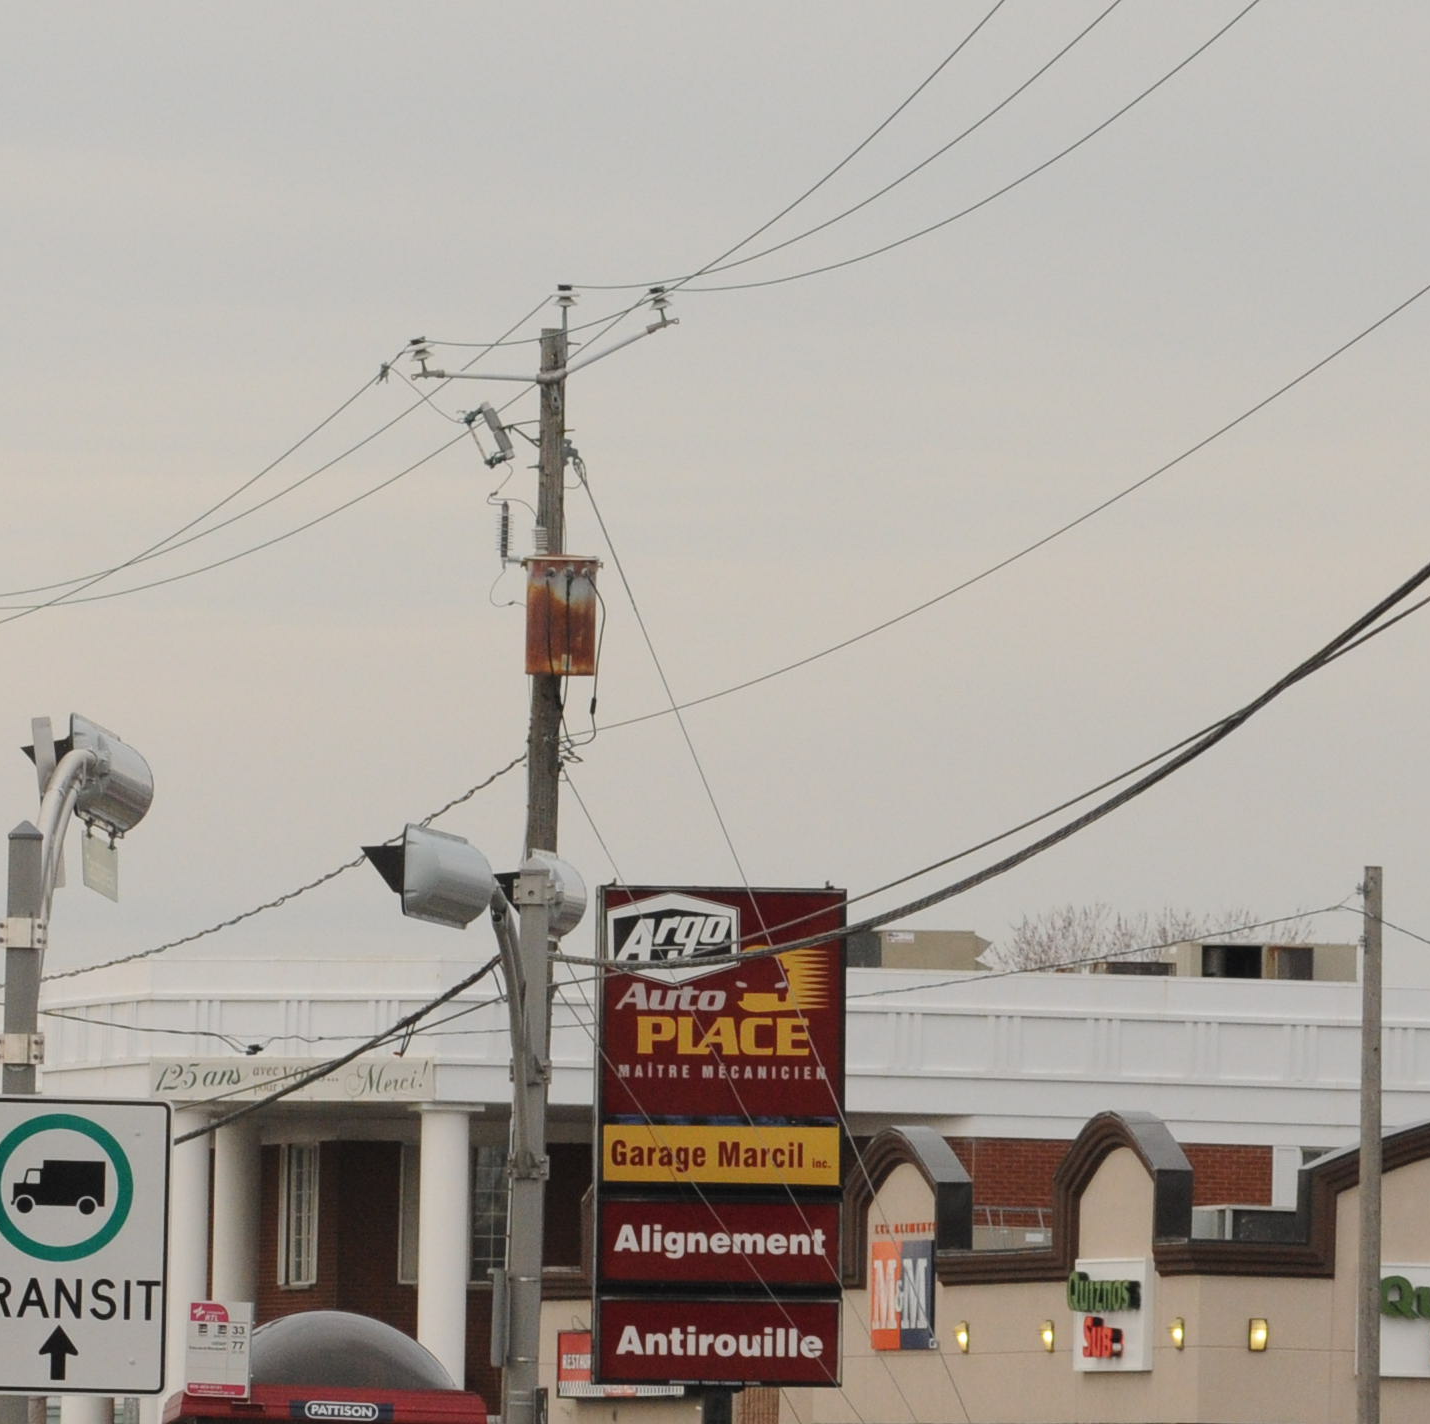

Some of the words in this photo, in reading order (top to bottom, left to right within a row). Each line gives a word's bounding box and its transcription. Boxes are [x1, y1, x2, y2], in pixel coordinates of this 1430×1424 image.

[615, 915, 732, 962] Argo
[615, 982, 727, 1011] Auto
[637, 1016, 810, 1056] PLACE
[155, 1063, 200, 1092] 125
[202, 1066, 242, 1086] ans
[345, 1060, 429, 1096] Merci!
[702, 1063, 828, 1080] MÉCANICIEN
[611, 1139, 707, 1173] Garage
[718, 1140, 804, 1169] Marcil
[812, 1158, 832, 1169] inc.
[613, 1223, 827, 1260] Alignement
[873, 1258, 928, 1329] M&M
[1067, 1271, 1141, 1313] Quiznos
[232, 1325, 245, 1335] 33
[232, 1341, 244, 1350] 77
[616, 1324, 824, 1359] Antirouille
[310, 1404, 373, 1418] PATTISON
